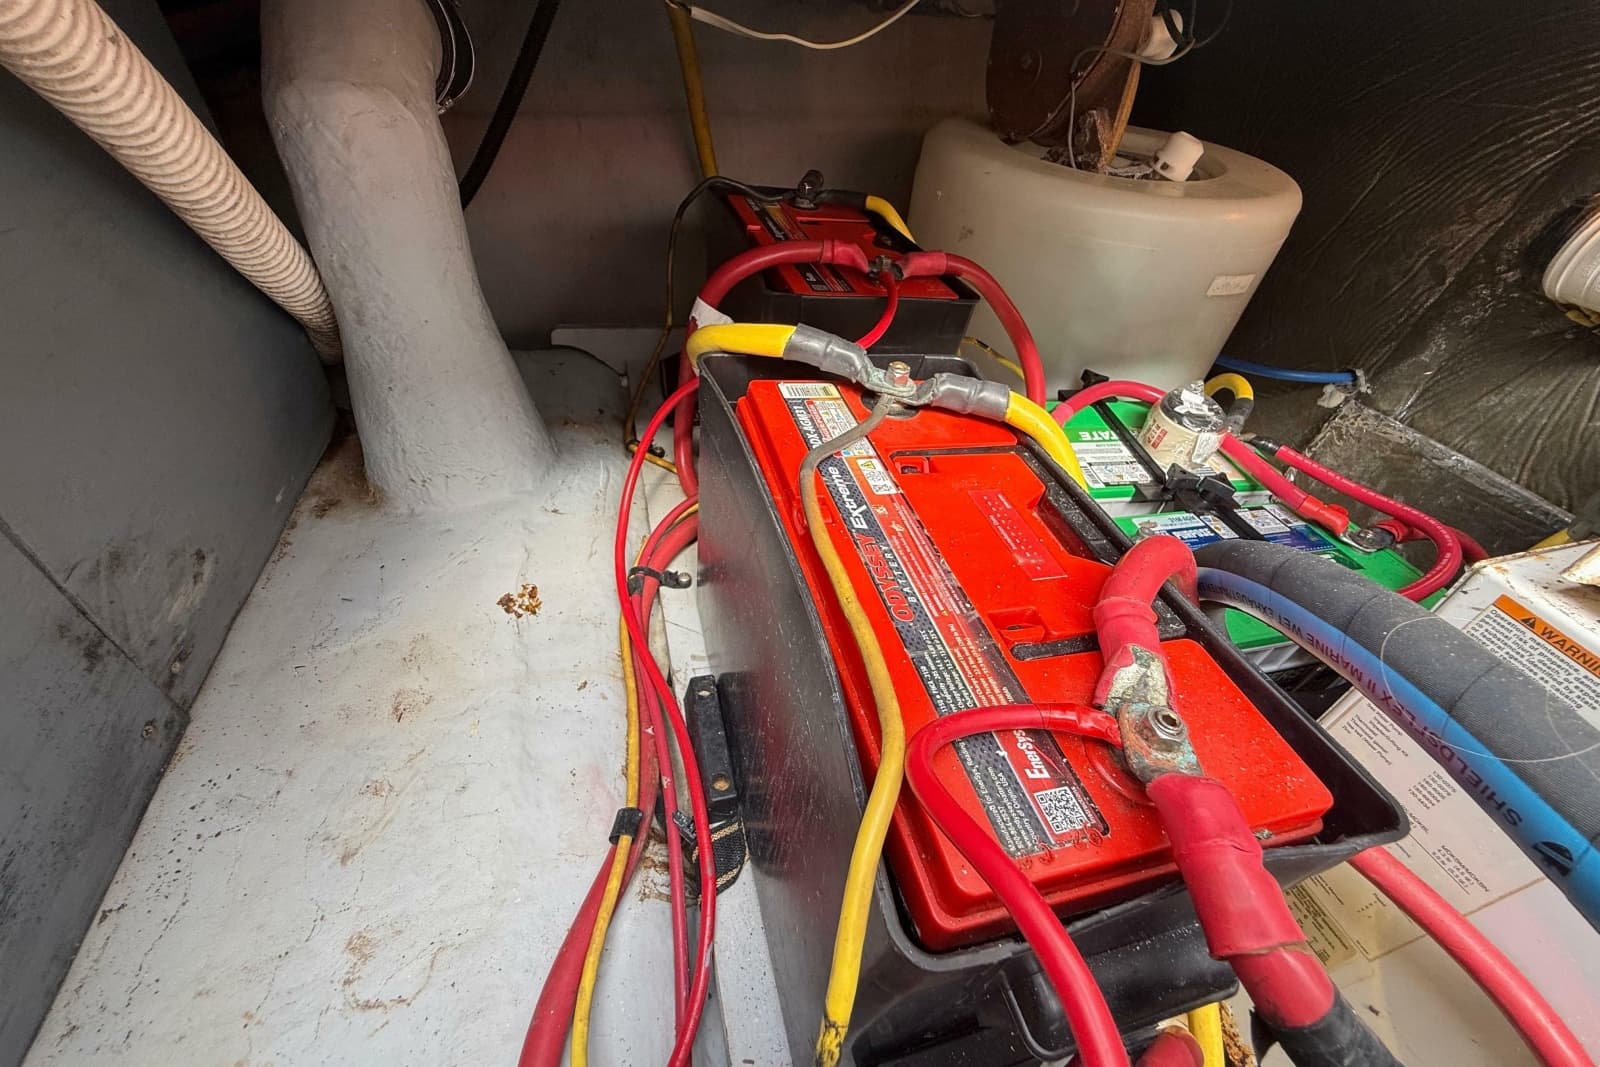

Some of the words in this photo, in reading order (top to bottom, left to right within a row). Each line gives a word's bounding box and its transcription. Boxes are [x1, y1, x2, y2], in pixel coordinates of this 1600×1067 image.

[829, 465, 868, 529] Extreme
[855, 532, 915, 622] ODYSSEY
[881, 544, 917, 603] BATTERY
[1277, 614, 1304, 640] WET
[1489, 608, 1528, 638] Operation,
[1528, 635, 1581, 675] maintenance,
[1306, 632, 1365, 682] MARINE
[996, 771, 1009, 786] USA
[1013, 730, 1050, 778] EnerSys
